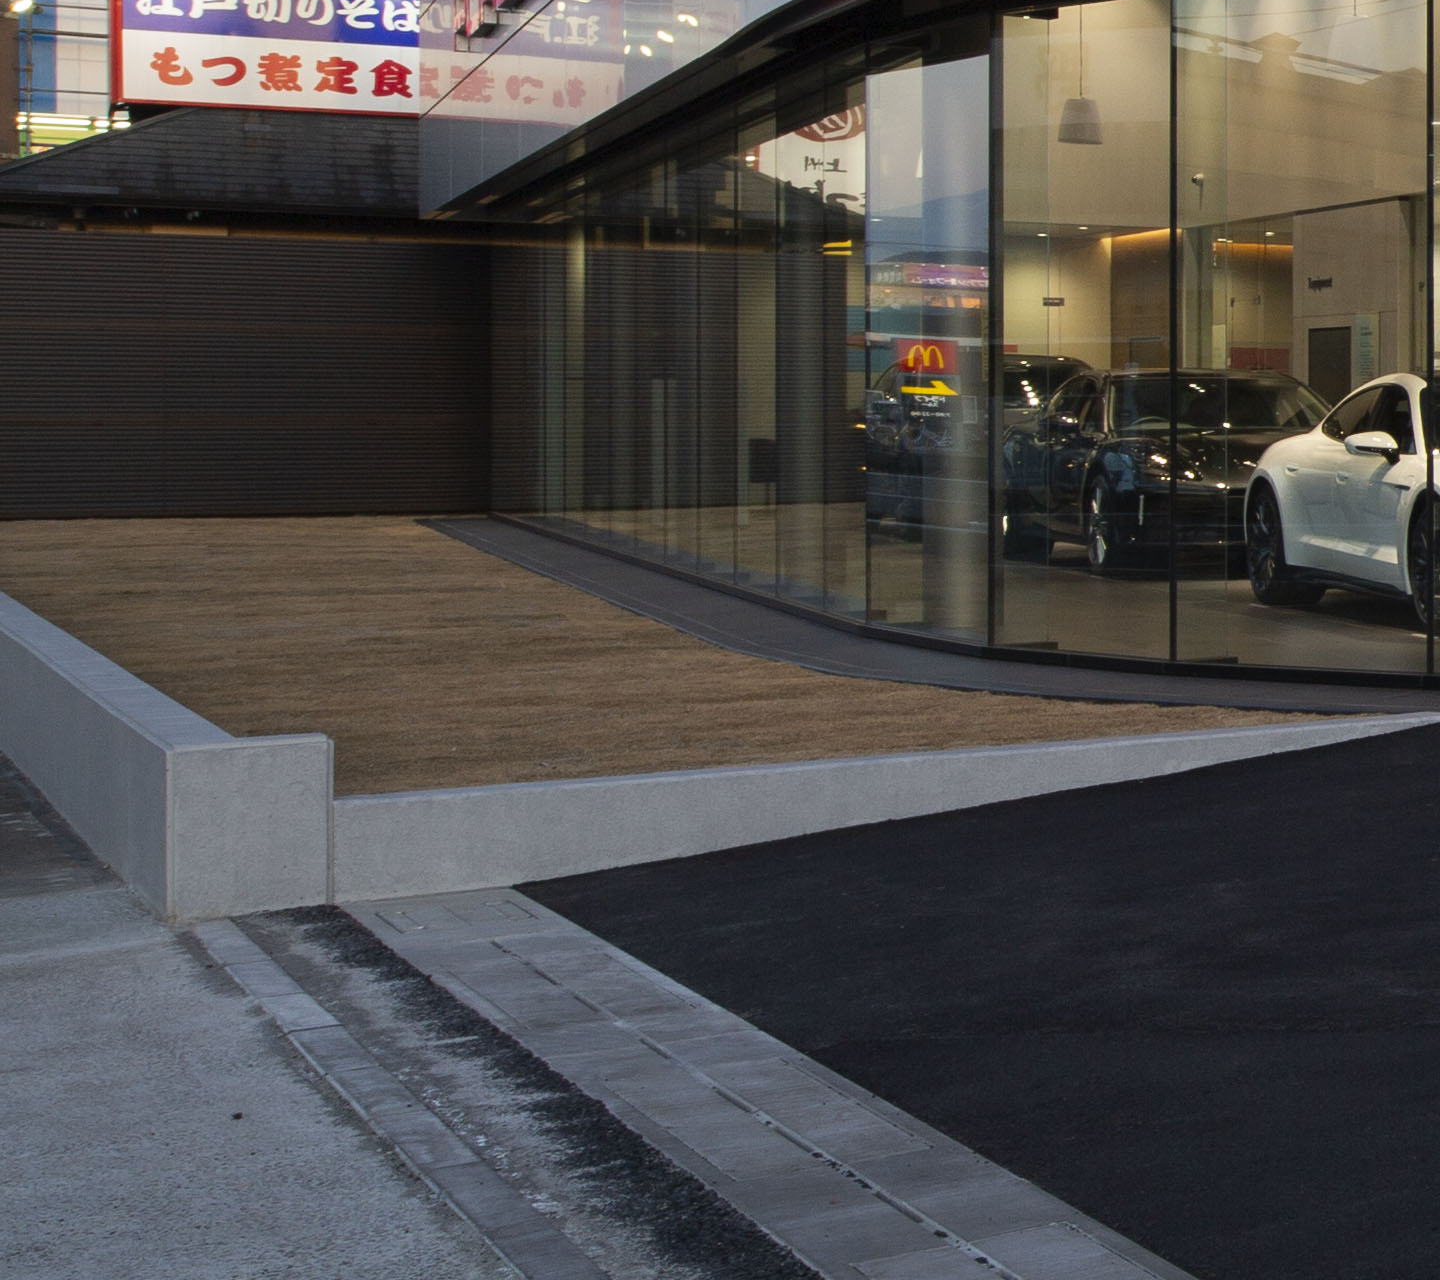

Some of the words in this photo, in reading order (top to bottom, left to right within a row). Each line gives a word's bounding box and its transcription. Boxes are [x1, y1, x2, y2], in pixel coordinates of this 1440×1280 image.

[150, 46, 414, 99] もつ煮定食
